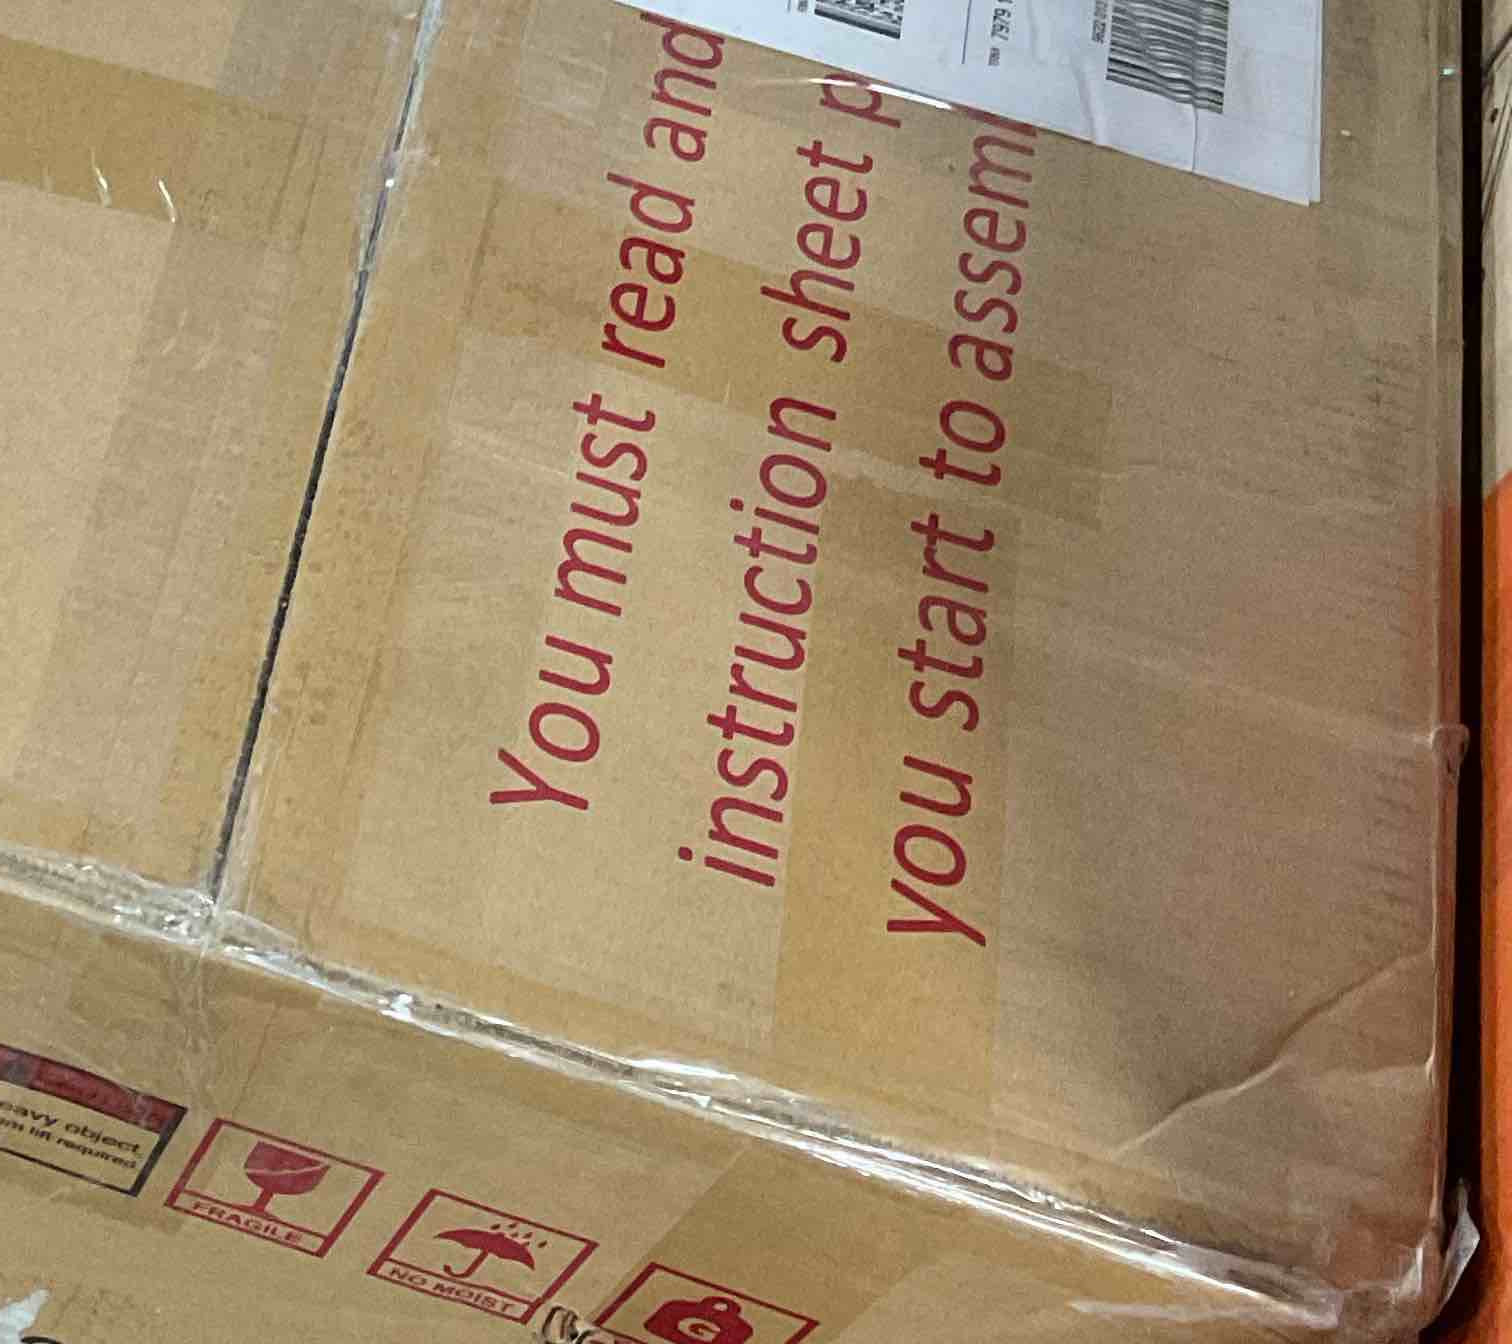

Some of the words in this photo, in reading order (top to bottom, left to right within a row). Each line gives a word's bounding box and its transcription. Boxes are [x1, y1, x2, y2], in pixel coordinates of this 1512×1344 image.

[639, 9, 726, 163] and
[991, 8, 1011, 41] 7979
[600, 173, 696, 369] read
[943, 104, 1040, 382] assem
[553, 392, 657, 617] must
[678, 395, 838, 889] instruction
[760, 139, 874, 365] sheet
[920, 398, 1009, 488] to
[896, 510, 998, 734] start
[489, 634, 615, 812] You
[886, 754, 987, 948] you
[28, 1122, 54, 1143] lift
[55, 1135, 138, 1170] required
[64, 1120, 142, 1155] object
[190, 1198, 307, 1245] FRAGILE
[389, 1266, 431, 1291] NO
[432, 1278, 516, 1316] MOIST
